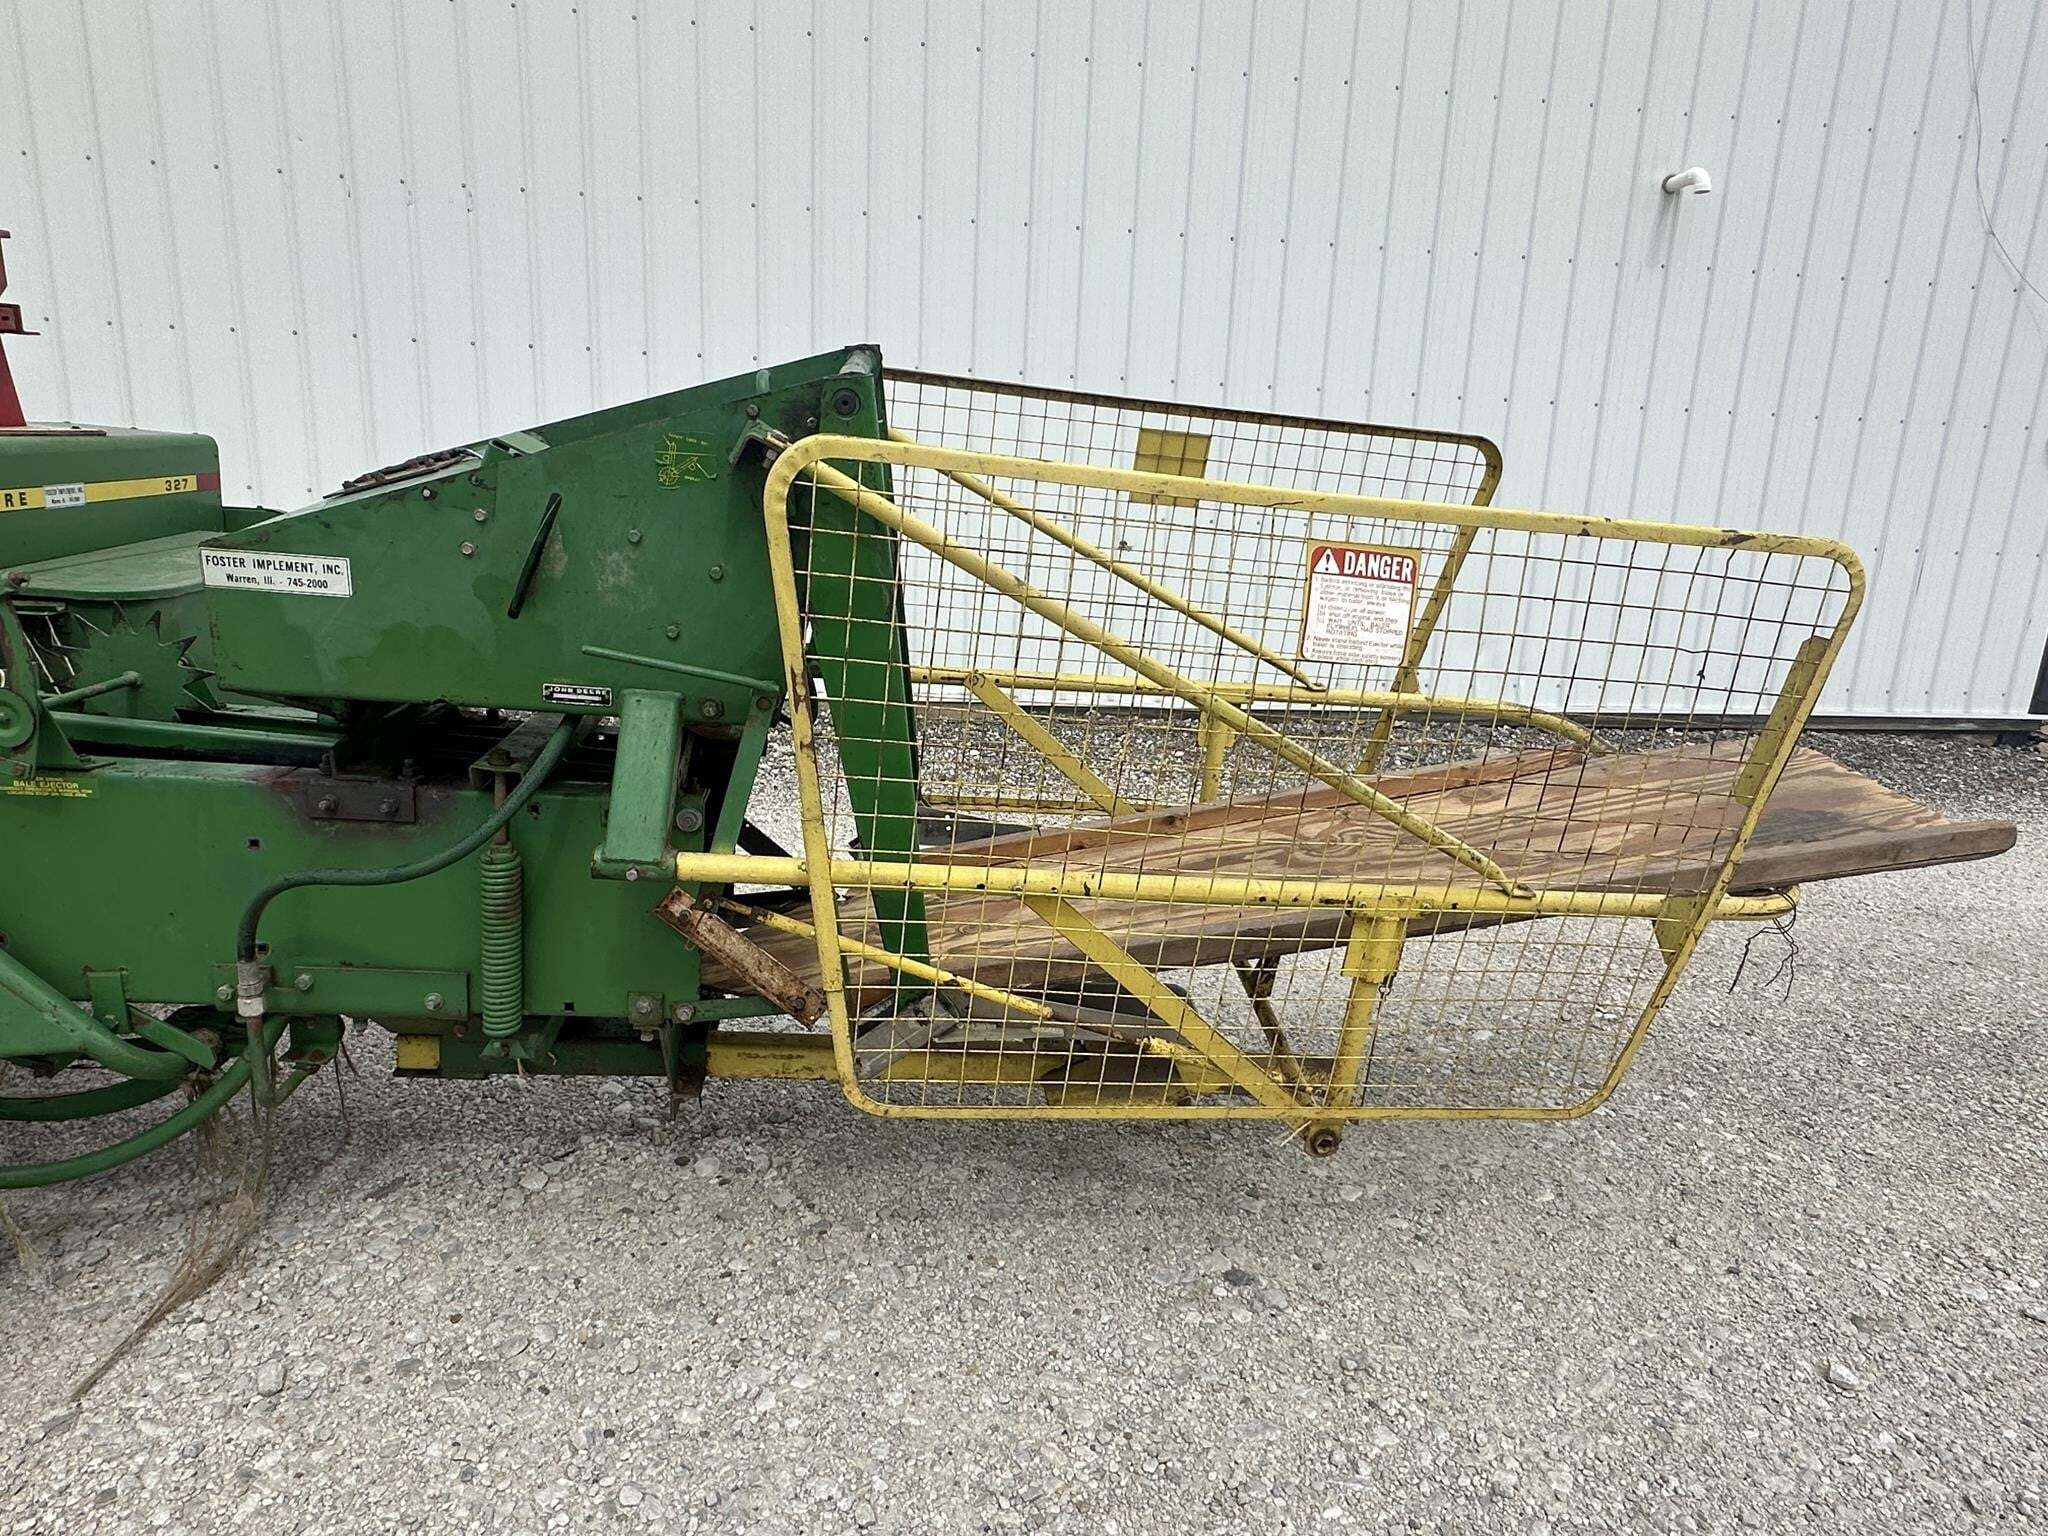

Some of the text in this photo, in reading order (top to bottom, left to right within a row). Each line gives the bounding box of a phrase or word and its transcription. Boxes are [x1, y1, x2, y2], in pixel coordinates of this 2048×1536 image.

[165, 478, 189, 491] 327
[205, 555, 344, 576] FOSTER IMPLEMENT, INC.
[1343, 550, 1413, 582] DANGER
[225, 573, 260, 585] Warren,
[287, 577, 328, 589] 745-2000
[40, 781, 79, 789] EJECTOR
